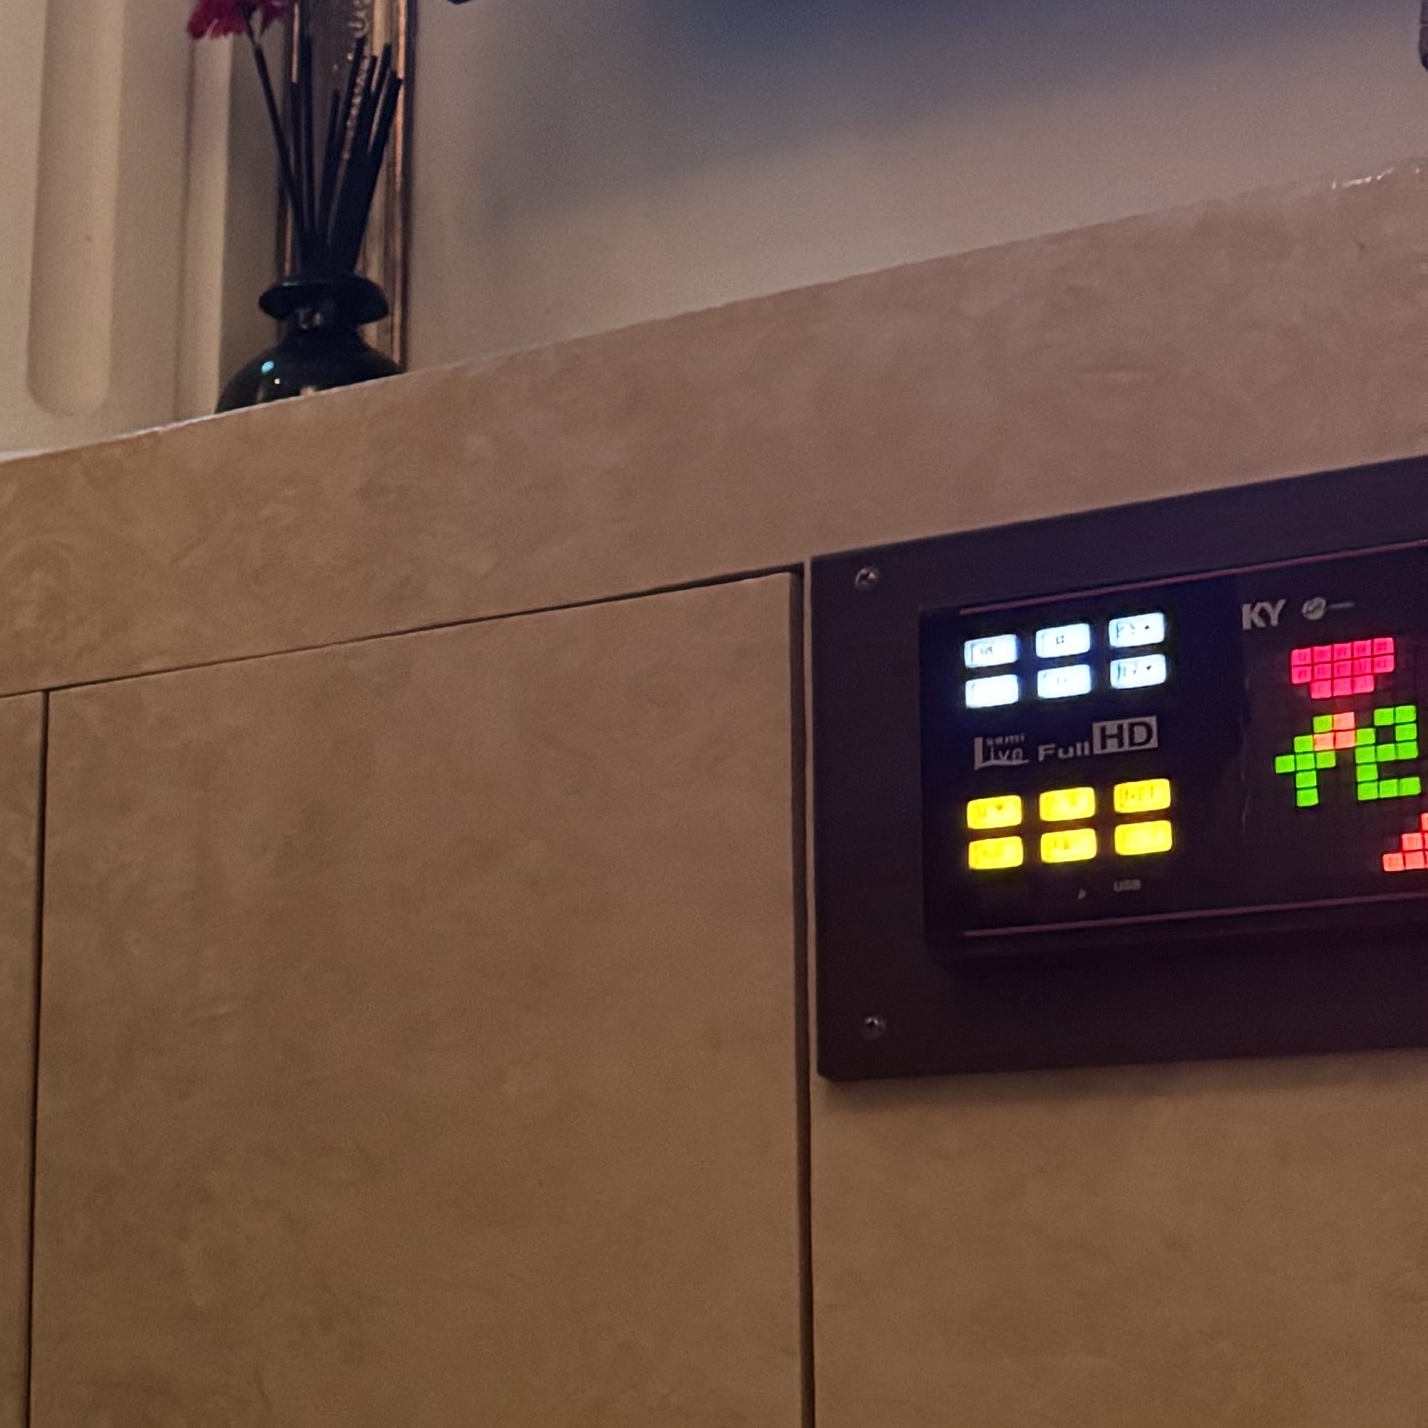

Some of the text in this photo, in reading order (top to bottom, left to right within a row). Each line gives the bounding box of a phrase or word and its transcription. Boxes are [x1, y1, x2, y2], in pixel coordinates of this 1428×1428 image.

[1241, 598, 1287, 631] KY
[1037, 740, 1091, 763] Full
[1098, 719, 1156, 752] HD
